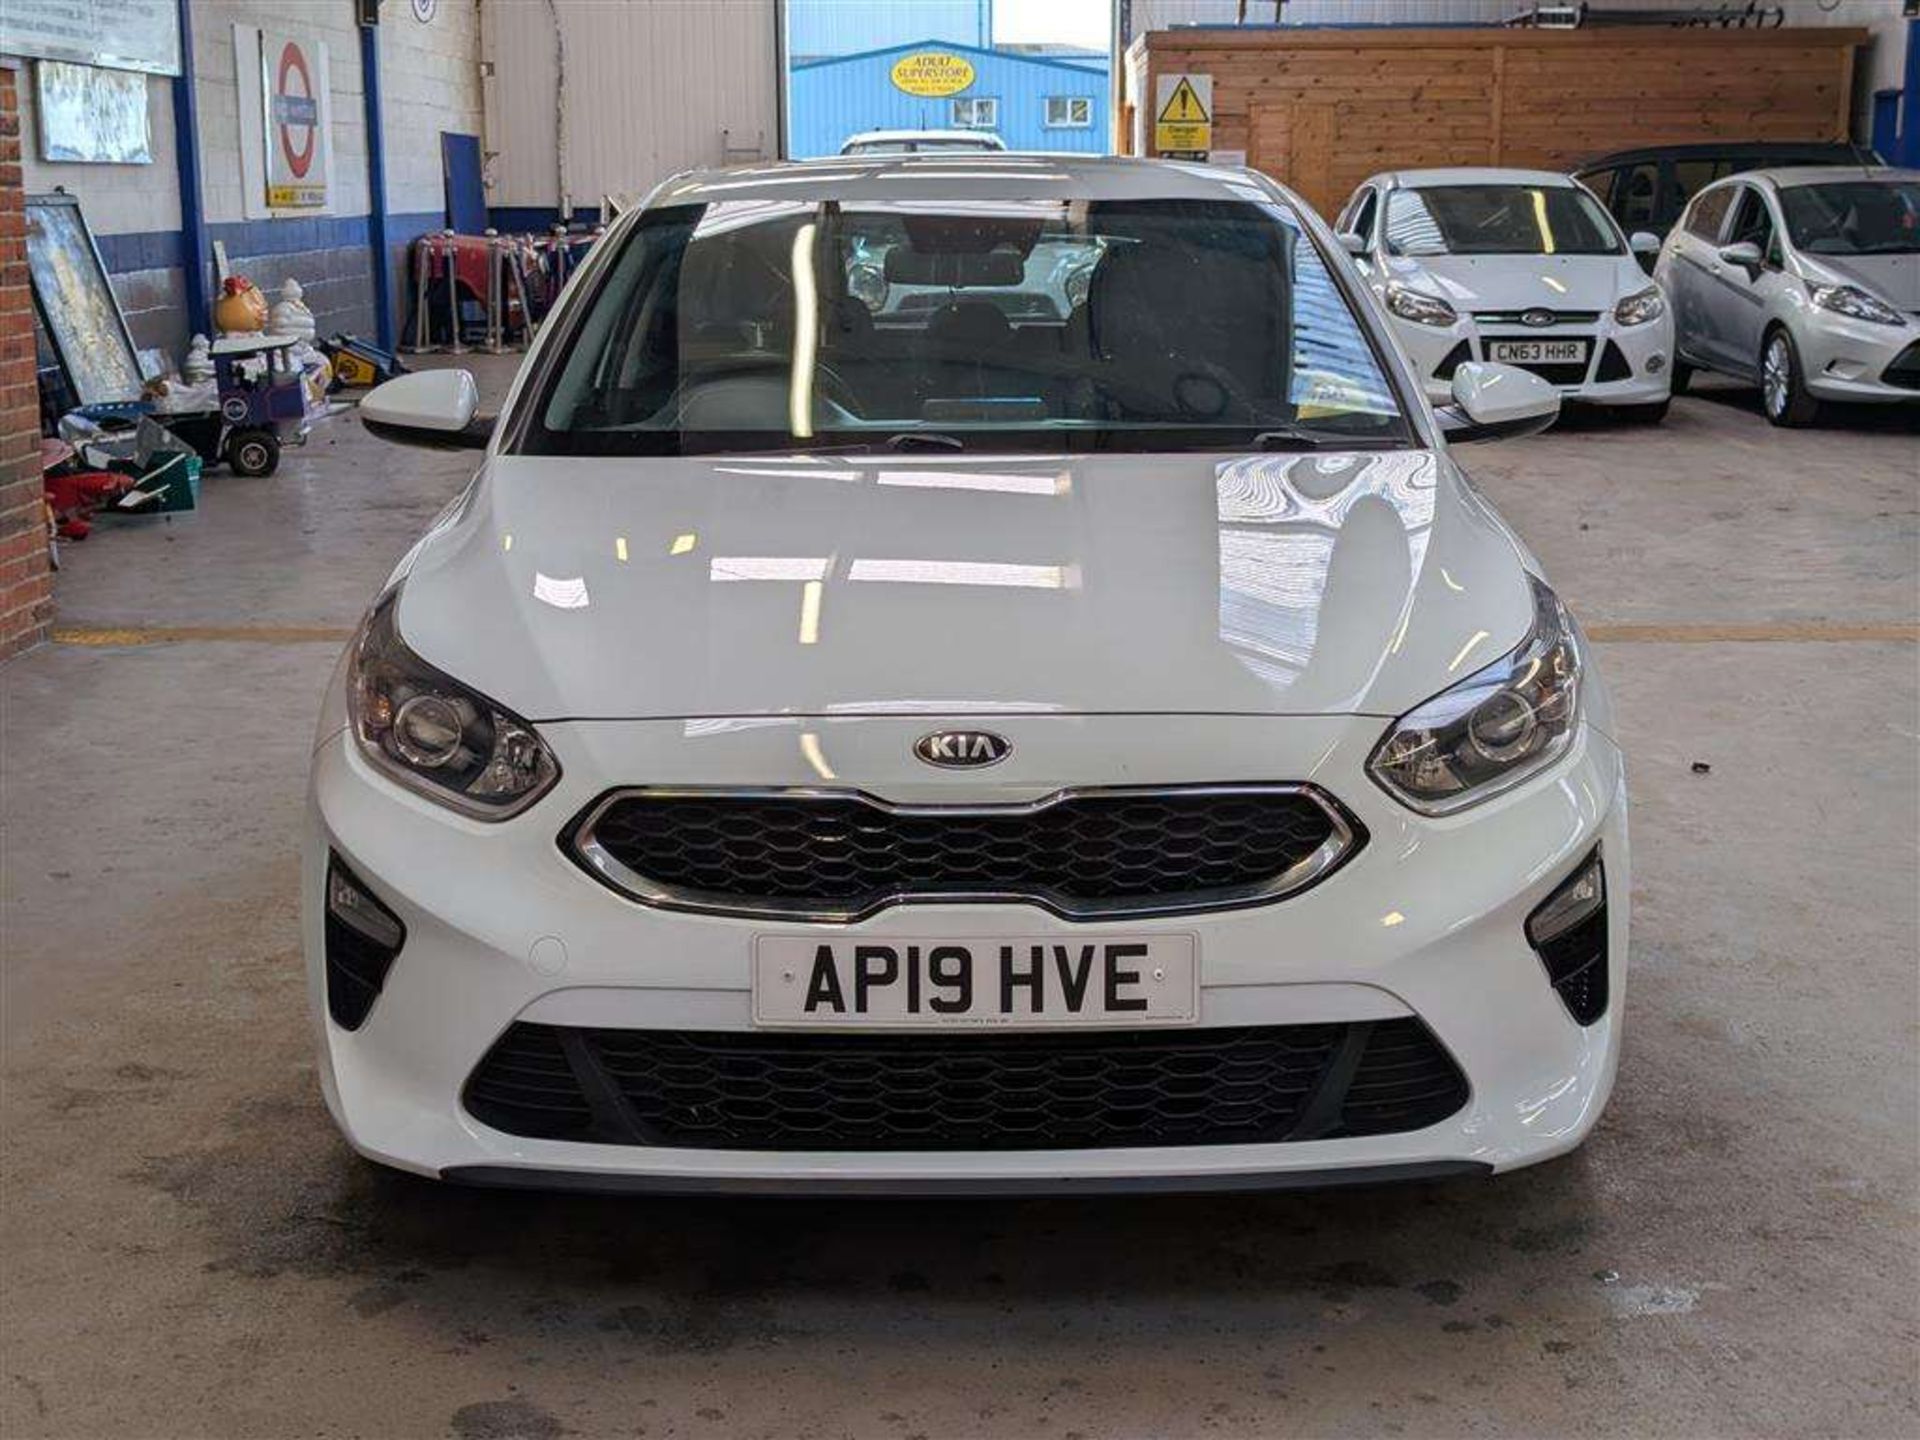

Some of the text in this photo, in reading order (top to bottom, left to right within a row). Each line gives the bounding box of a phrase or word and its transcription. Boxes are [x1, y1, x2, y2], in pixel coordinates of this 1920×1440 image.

[896, 67, 969, 78] SUPERSTORE
[1497, 344, 1578, 360] CN63 HHR
[931, 735, 996, 758] KIA
[804, 944, 1148, 1014] AP19 HVE
